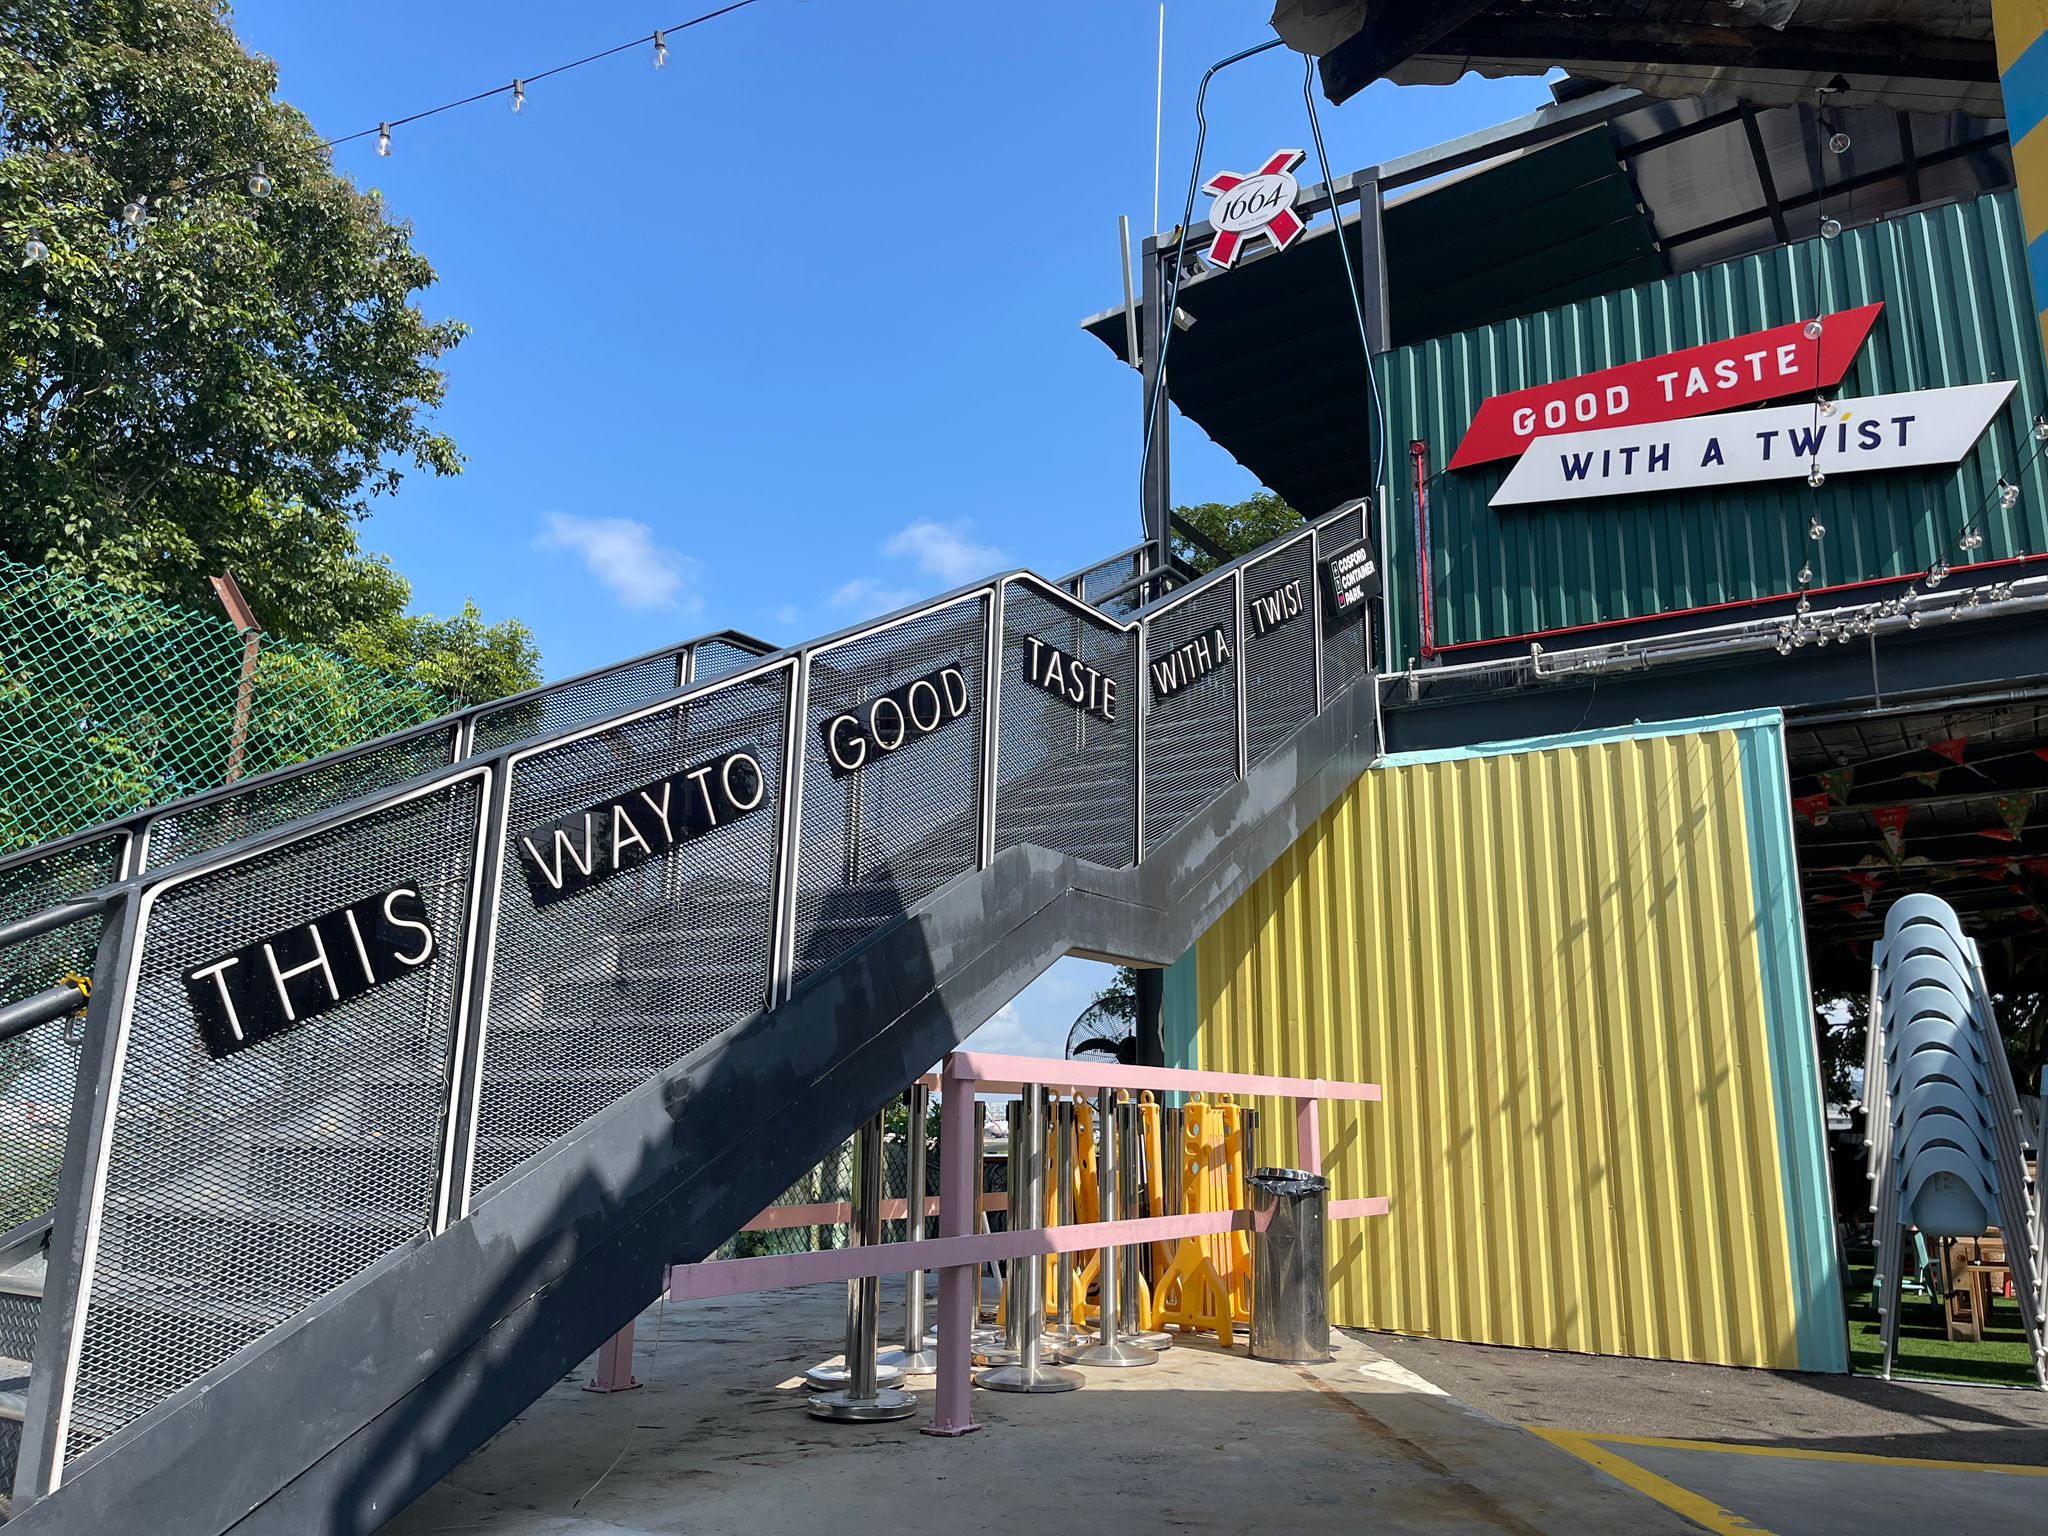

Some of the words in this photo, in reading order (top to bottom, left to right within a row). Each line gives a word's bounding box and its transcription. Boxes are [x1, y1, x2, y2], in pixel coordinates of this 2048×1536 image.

[1221, 182, 1289, 225] 1664
[1512, 385, 1630, 437] GOOD
[1656, 343, 1799, 402] TASTE
[1560, 442, 1670, 481] WITH
[1701, 437, 1725, 467] A
[1755, 413, 1916, 461] TWIST
[1338, 547, 1367, 573] COSFORD
[1341, 560, 1375, 589] CONTAINER
[1252, 580, 1302, 634] TWIST
[1344, 584, 1364, 605] PARK.
[1026, 636, 1116, 721] TASTE
[1152, 640, 1212, 695] WITH
[1214, 629, 1231, 662] A
[828, 667, 968, 772] GOOD
[523, 782, 673, 890] WAY
[688, 752, 765, 826] TO
[191, 888, 434, 1042] THIS
